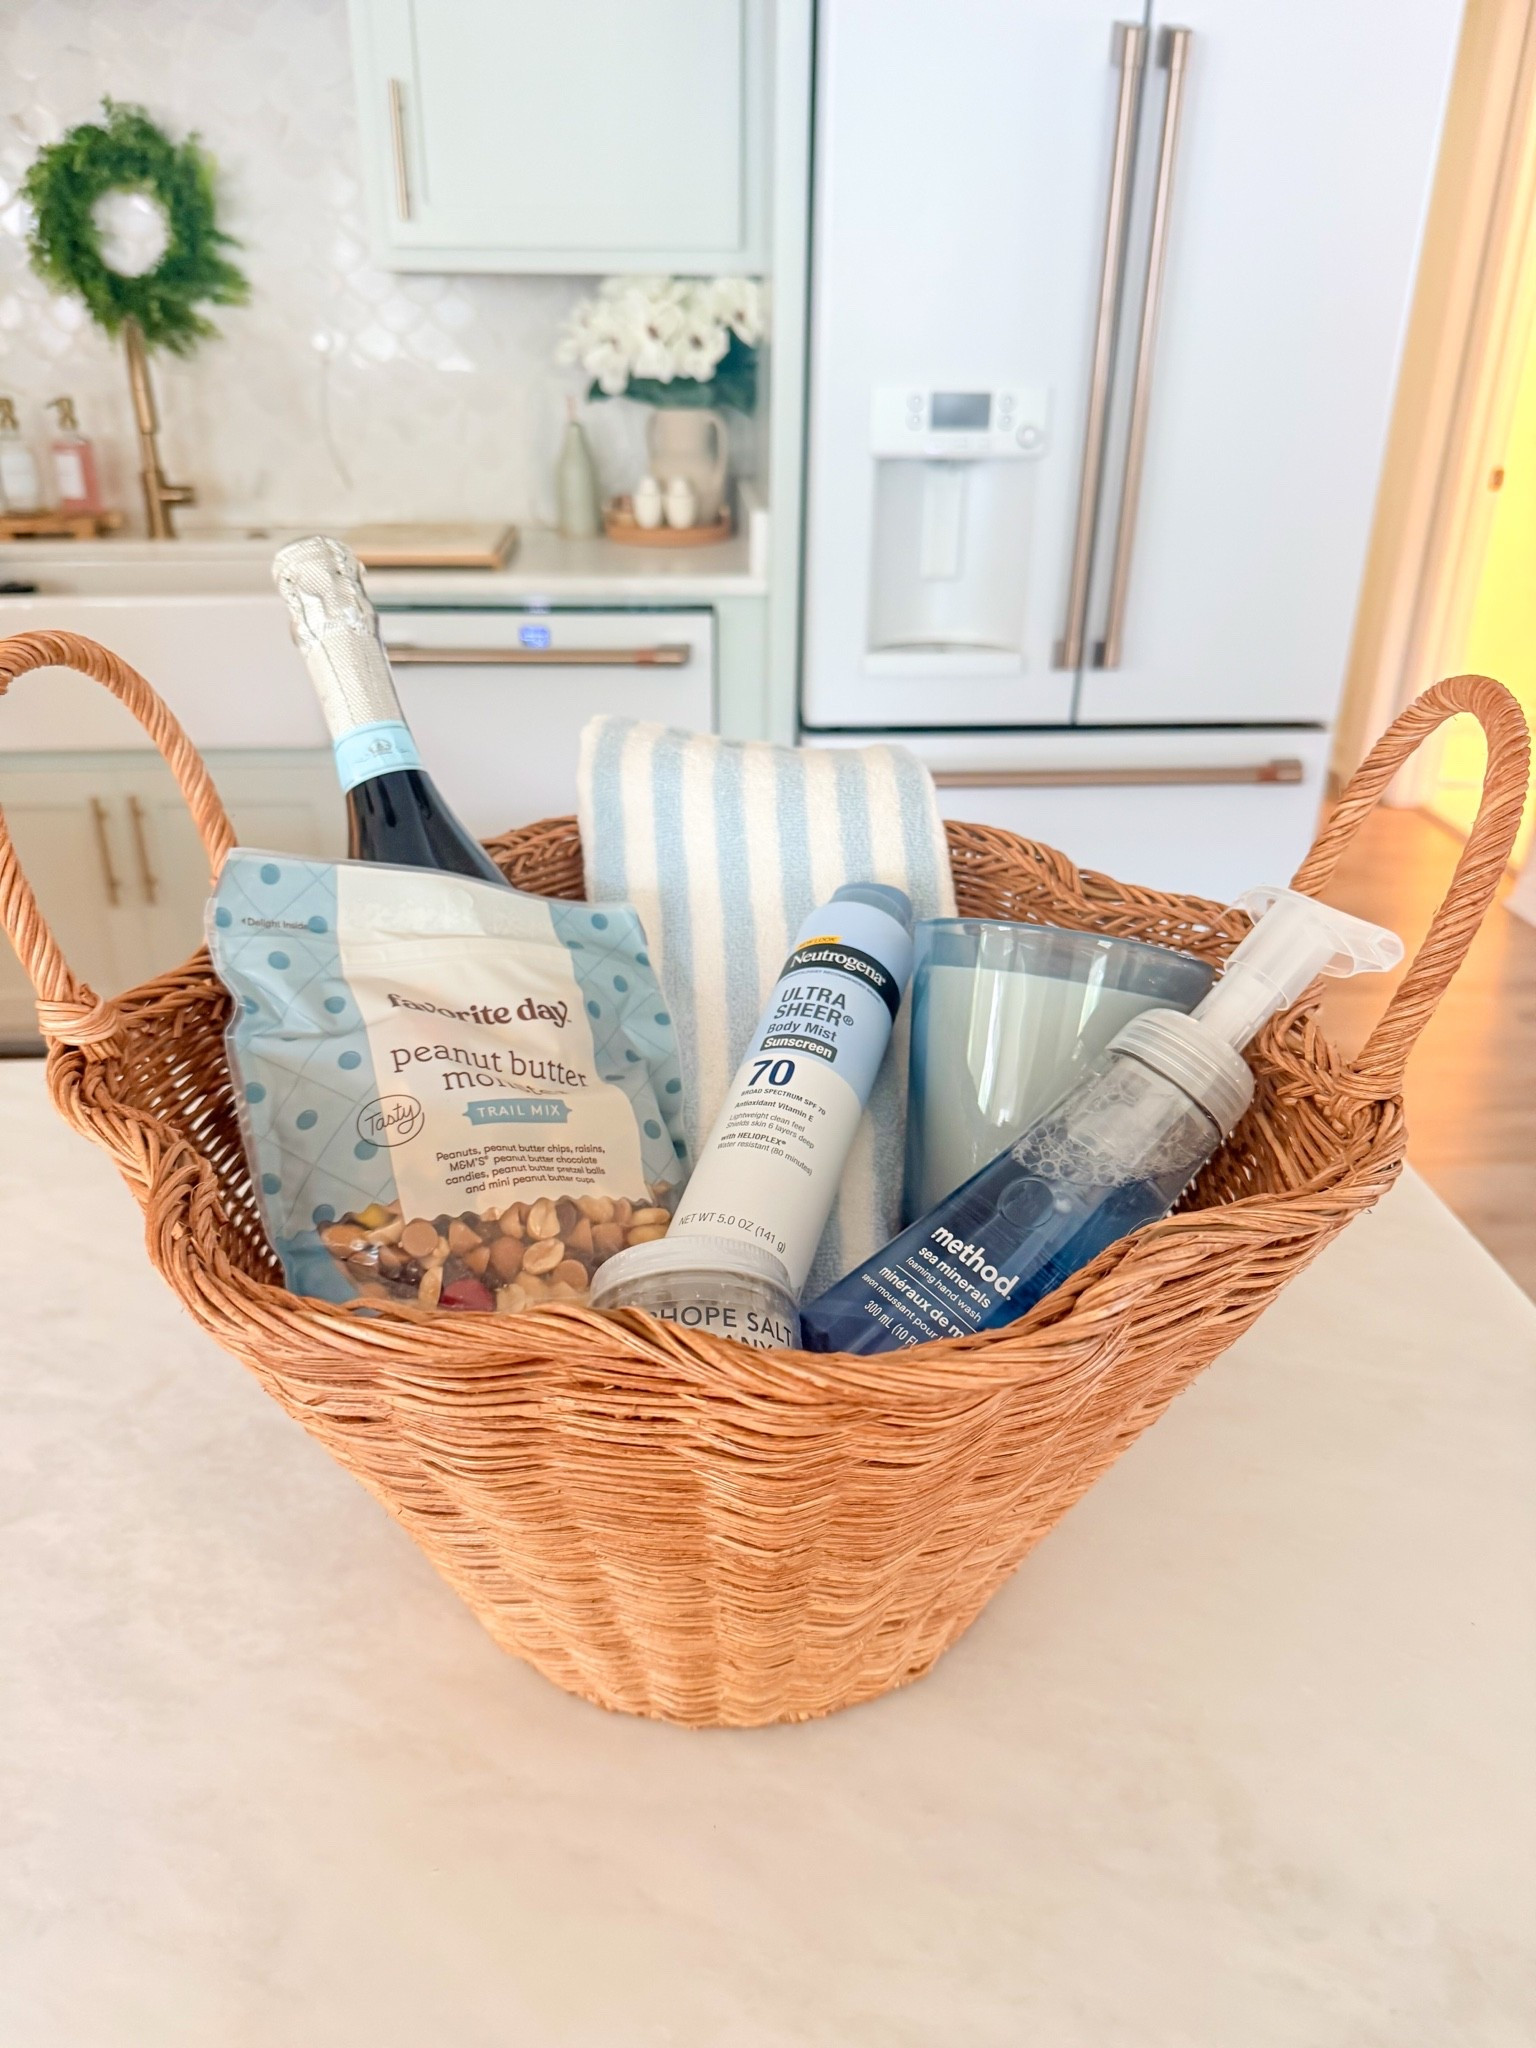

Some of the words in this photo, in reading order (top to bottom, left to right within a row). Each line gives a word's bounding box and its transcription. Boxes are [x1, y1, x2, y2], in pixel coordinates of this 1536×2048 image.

[247, 917, 280, 929] Delight
[387, 993, 512, 1024] favorite
[781, 986, 846, 1010] ULTRA
[767, 1021, 802, 1034] Body
[804, 1022, 838, 1043] Mist
[764, 1037, 833, 1059] Sunscreen
[390, 1044, 503, 1073] peanut
[508, 1050, 589, 1088] butter
[747, 1059, 796, 1087] 70
[476, 1106, 526, 1118] TRAIL
[530, 1104, 561, 1116] MIX
[734, 1099, 777, 1109] Antioxidant
[777, 1102, 807, 1119] Vitamin
[808, 1115, 815, 1123] E
[741, 1088, 763, 1097] BROAD
[763, 1088, 803, 1102] SPECTRUM
[803, 1098, 818, 1109] SPF
[818, 1106, 827, 1116] 70
[364, 1103, 415, 1136] Tasty
[729, 1111, 770, 1121] Lightweight
[769, 1116, 790, 1126] clean
[791, 1121, 806, 1133] feel
[720, 1132, 736, 1141] with
[726, 1119, 750, 1129] Shields
[750, 1120, 767, 1128] skin
[775, 1124, 798, 1138] layers
[798, 1134, 815, 1150] deep
[436, 1148, 482, 1162] Peanuts,
[484, 1144, 517, 1155] peanut
[518, 1143, 545, 1153] butter
[547, 1144, 574, 1155] chips,
[575, 1144, 606, 1154] raisins,
[493, 1154, 527, 1164] peanut
[528, 1154, 554, 1163] butter
[556, 1154, 598, 1164] chocolate
[717, 1140, 736, 1150] Water
[736, 1141, 770, 1152] resistant
[770, 1147, 784, 1158] (80
[784, 1153, 813, 1177] minutes)
[445, 1169, 490, 1186] candies,
[492, 1164, 528, 1178] peanut
[528, 1163, 555, 1173] butter
[556, 1165, 585, 1175] pretzel
[585, 1165, 606, 1175] balls
[465, 1183, 486, 1195] and
[488, 1178, 511, 1191] mini
[512, 1174, 547, 1187] peanut
[548, 1174, 574, 1183] butter
[575, 1176, 596, 1185] cups
[678, 1213, 698, 1226] NET
[697, 1212, 717, 1222] WT
[716, 1213, 736, 1226] 5.0
[737, 1218, 755, 1232] OZ
[754, 1226, 776, 1245] (141
[776, 1241, 787, 1254] g)
[905, 1256, 937, 1284] foaming
[934, 1280, 960, 1302] hand
[957, 1299, 982, 1323] wash
[918, 1247, 939, 1265] sea
[936, 1261, 992, 1309] minerals
[861, 1273, 879, 1289] savon
[876, 1284, 917, 1321] moussant
[912, 1313, 939, 1339] pour
[878, 1266, 932, 1313] minéraux
[929, 1308, 950, 1328] de
[650, 1306, 738, 1328] HOPE
[746, 1312, 793, 1347] SALT
[864, 1300, 882, 1317] 300
[878, 1313, 895, 1329] mL
[891, 1323, 909, 1341] (10
